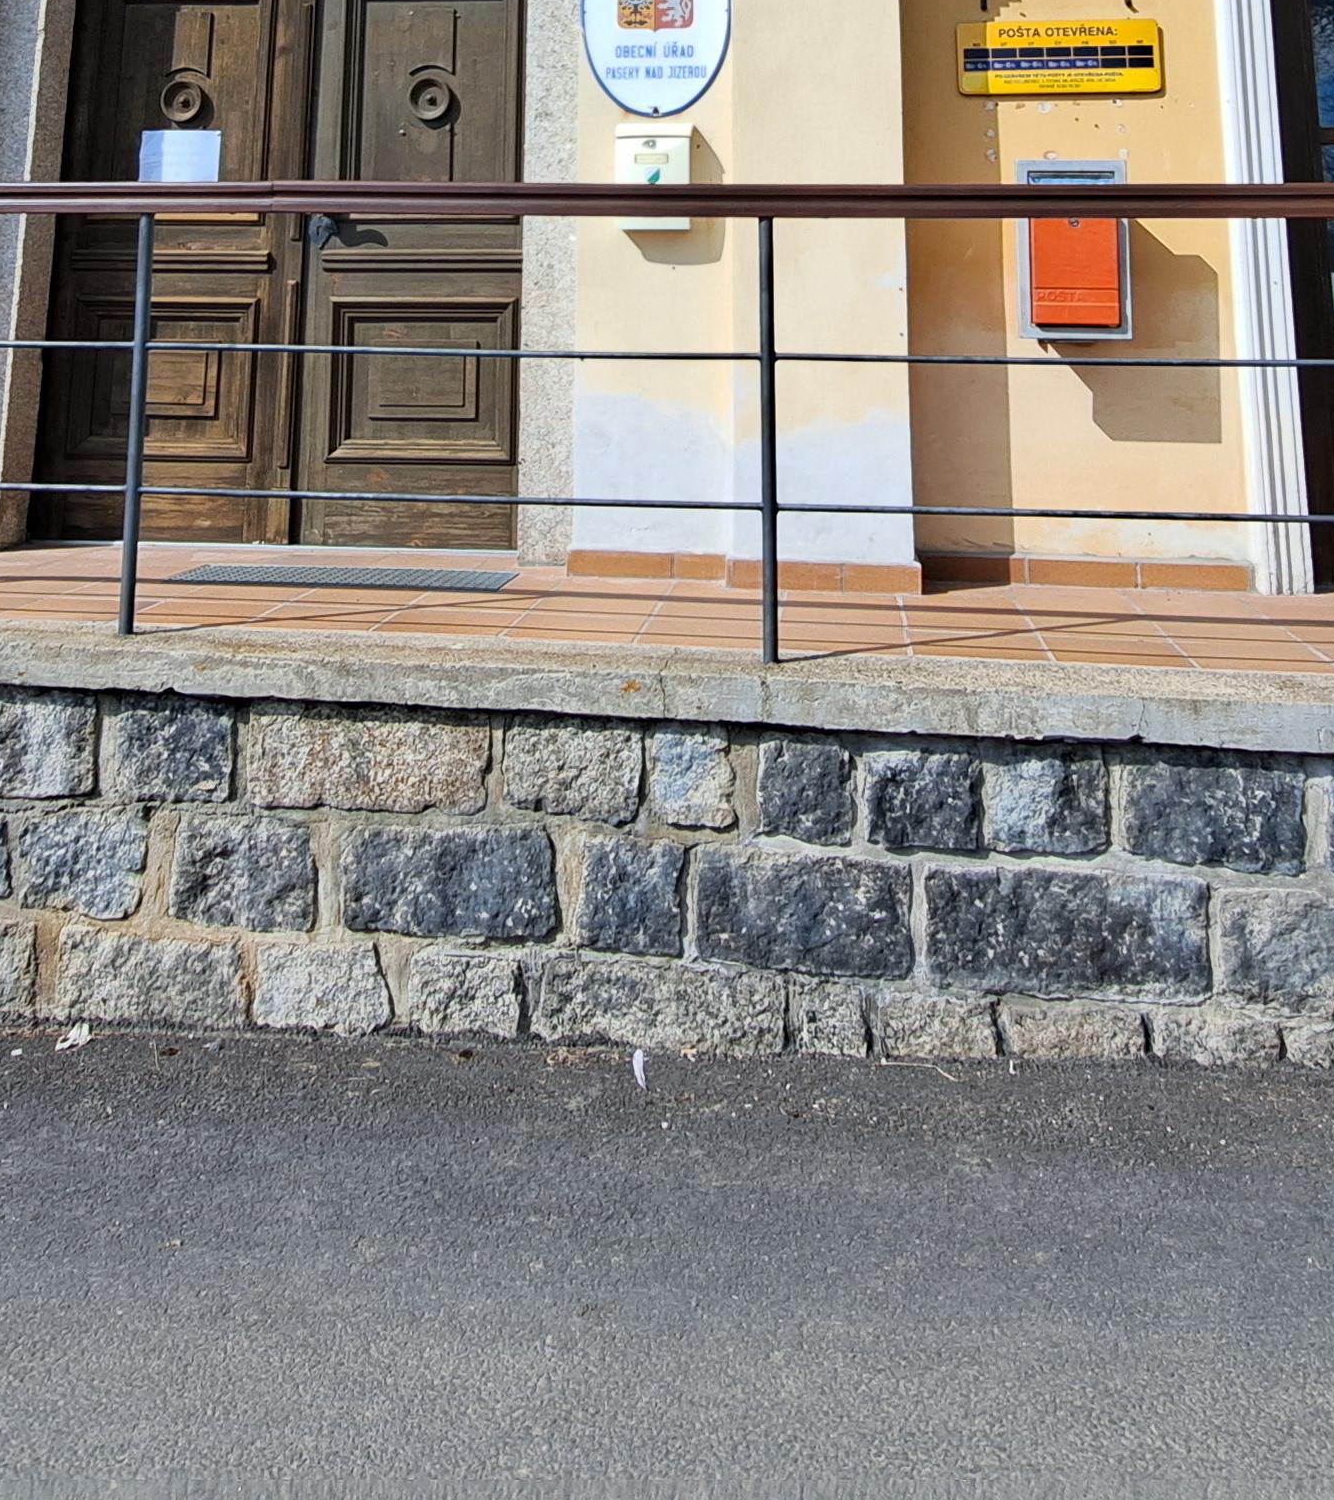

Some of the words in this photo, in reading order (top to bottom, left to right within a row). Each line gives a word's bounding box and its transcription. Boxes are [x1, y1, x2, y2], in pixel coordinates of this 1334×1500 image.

[998, 25, 1041, 38] POŠTA
[1045, 23, 1118, 37] OTEVŘENA:
[615, 42, 657, 59] OBECNÍ
[663, 41, 695, 58] ÚŘAD
[605, 66, 639, 80] PASEKY
[644, 65, 664, 79] NAD
[668, 64, 707, 79] JIZEROU
